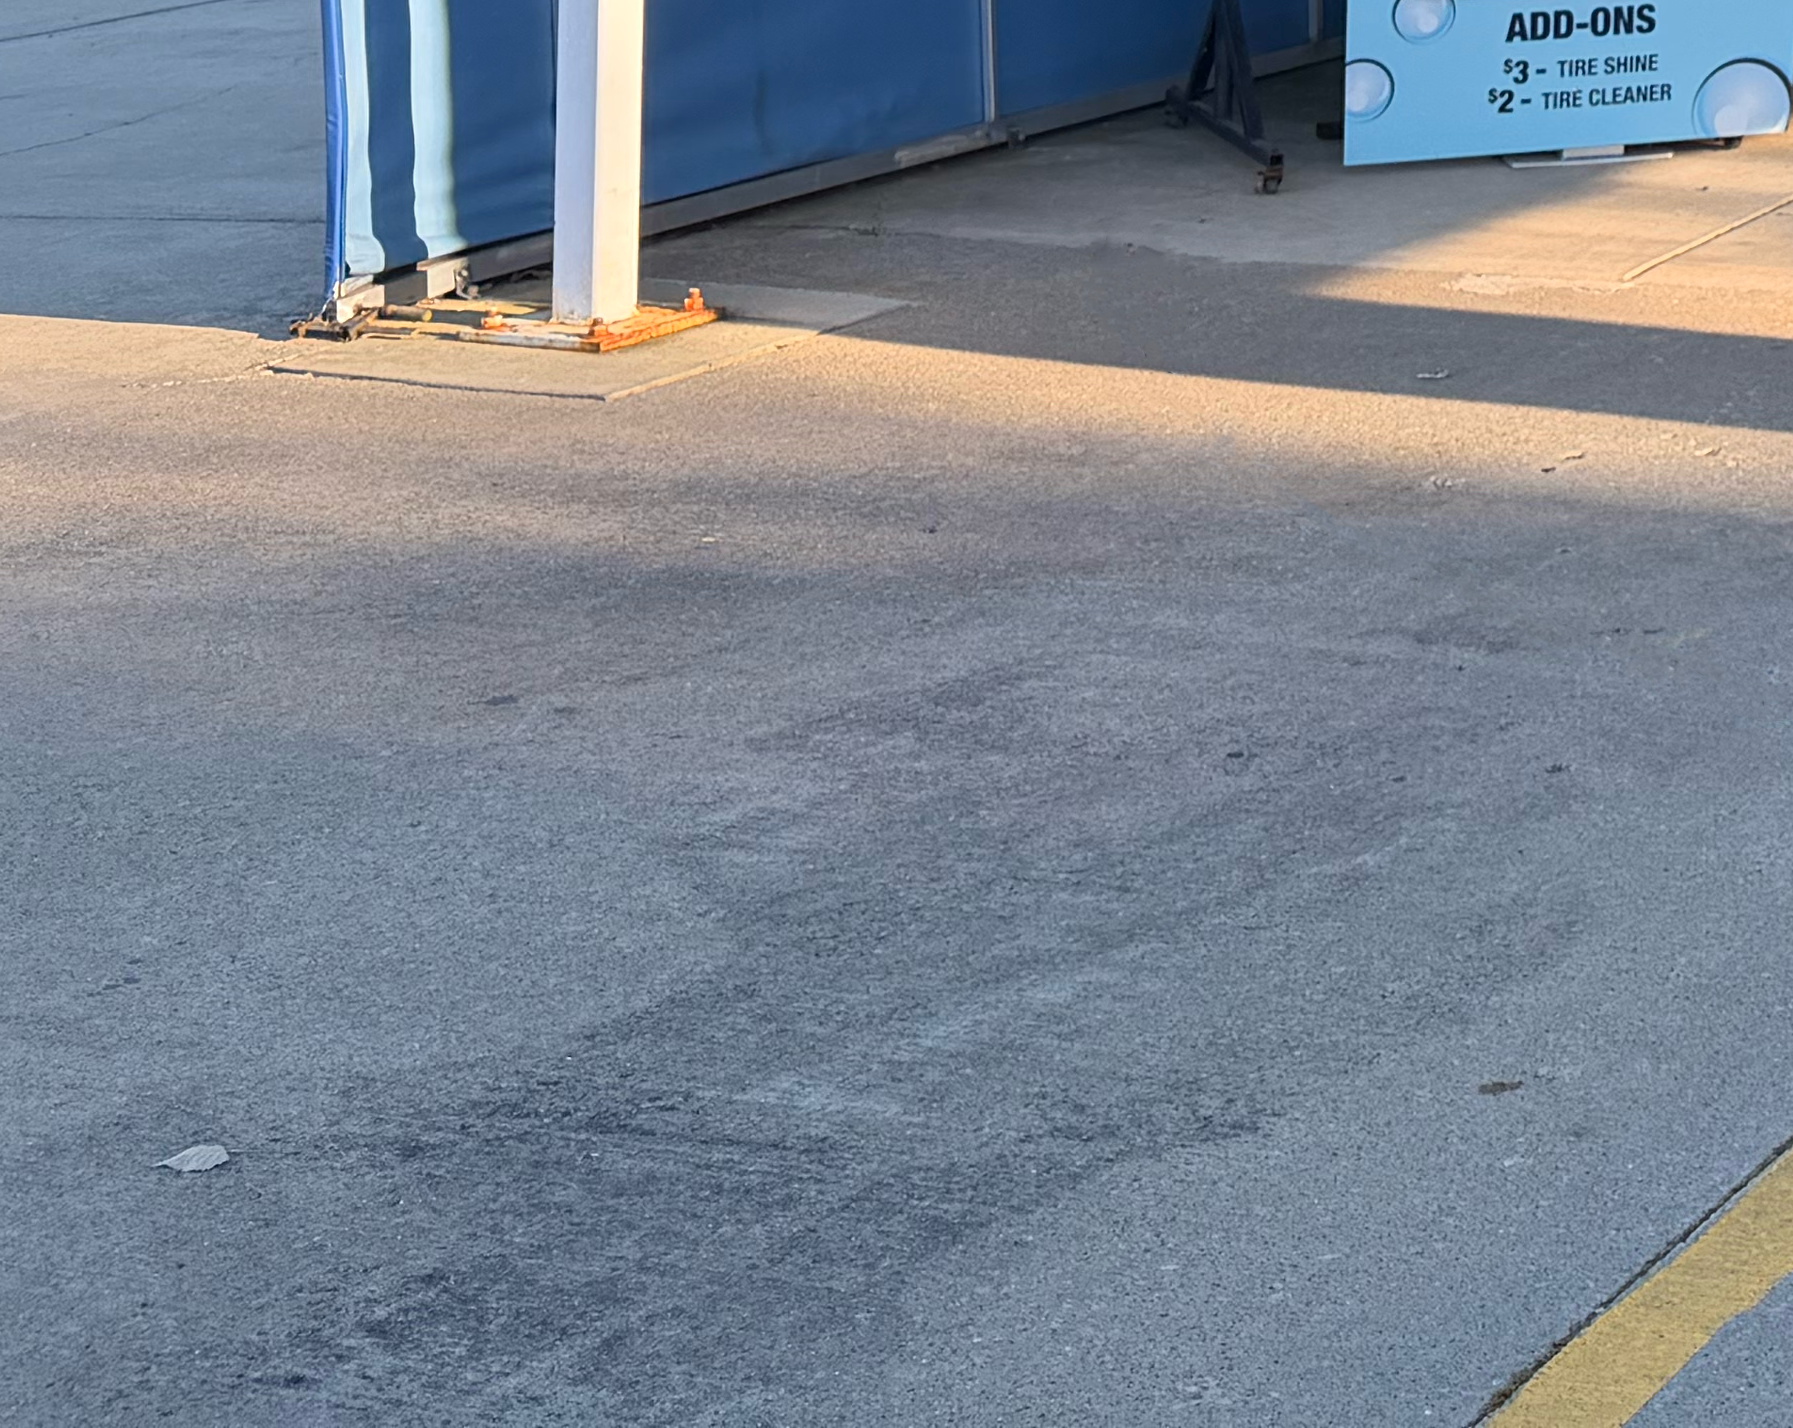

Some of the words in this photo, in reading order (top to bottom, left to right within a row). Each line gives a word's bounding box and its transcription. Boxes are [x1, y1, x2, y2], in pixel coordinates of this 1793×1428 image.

[1505, 3, 1656, 43] ADD-ONS
[1503, 58, 1530, 84] $3
[1557, 58, 1598, 78] TIRE
[1604, 54, 1659, 75] SHINE
[1488, 88, 1515, 114] $2
[1541, 90, 1583, 110] TIRE
[1588, 84, 1672, 107] CLEANER
